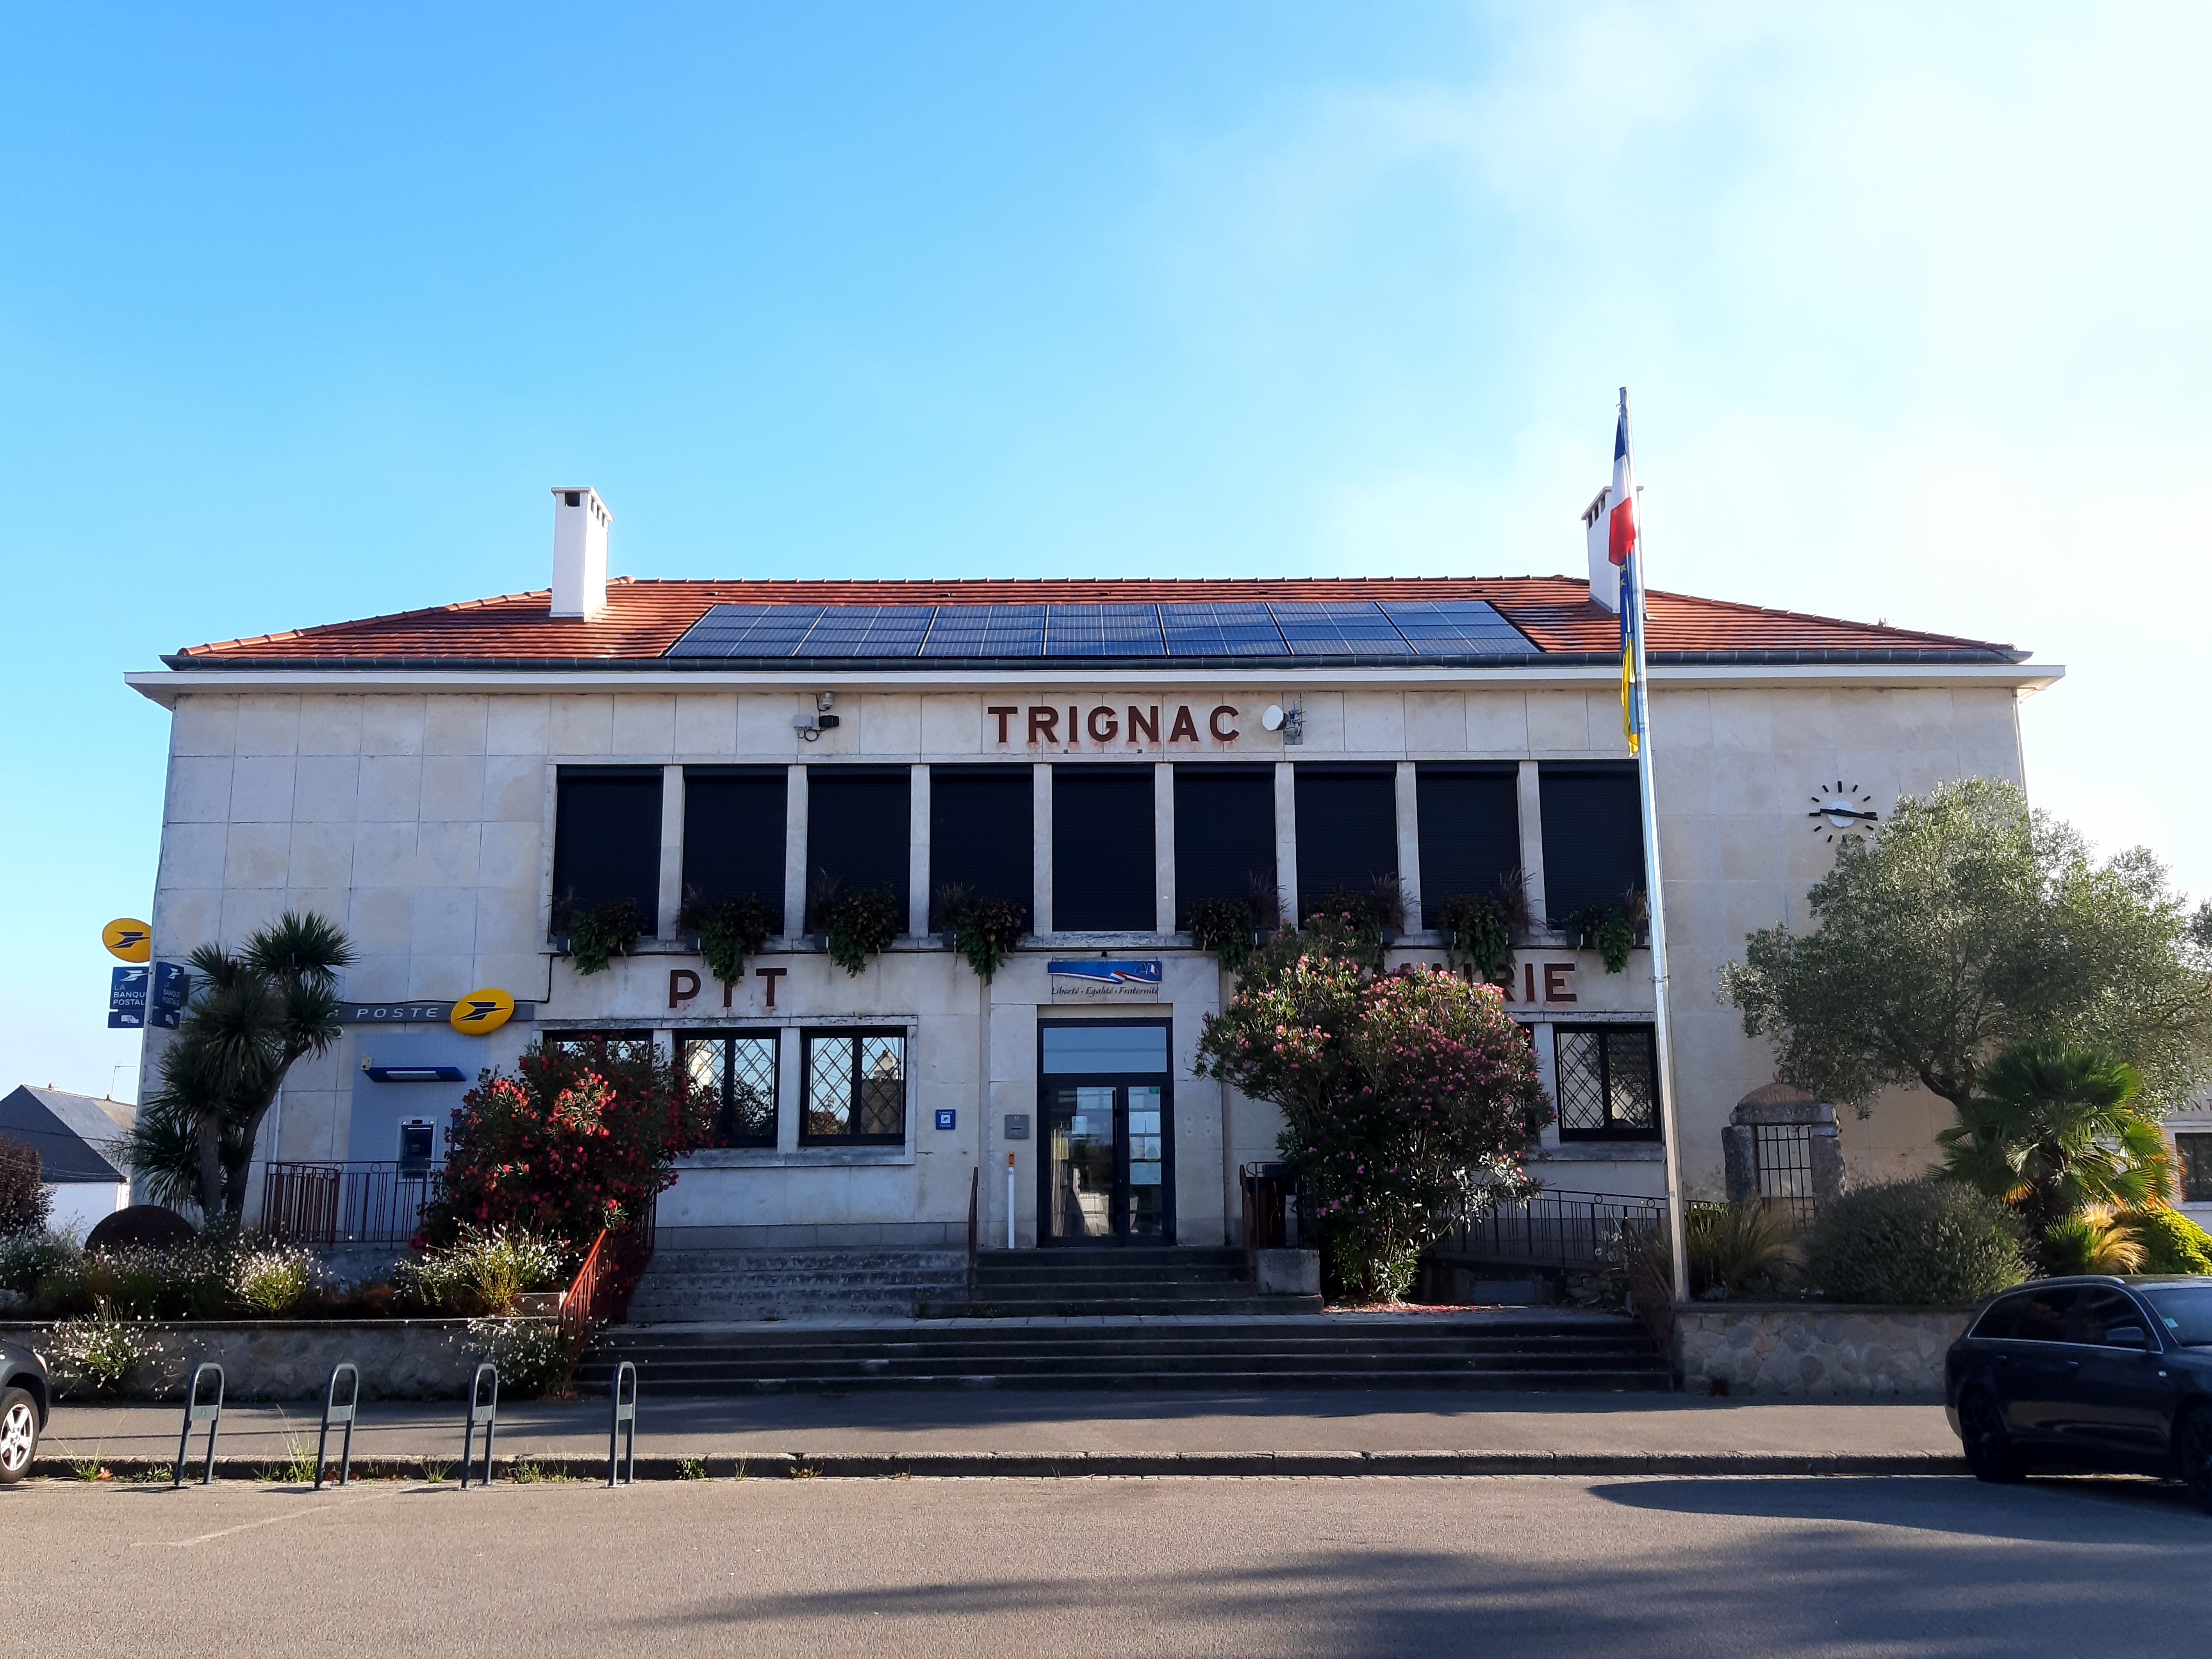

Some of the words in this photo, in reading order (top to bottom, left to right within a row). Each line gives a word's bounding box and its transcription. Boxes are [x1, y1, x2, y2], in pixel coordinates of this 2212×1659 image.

[988, 705, 1240, 743] TRIGNAC
[1051, 986, 1079, 994] Liberté
[356, 1008, 439, 1018] POSTE
